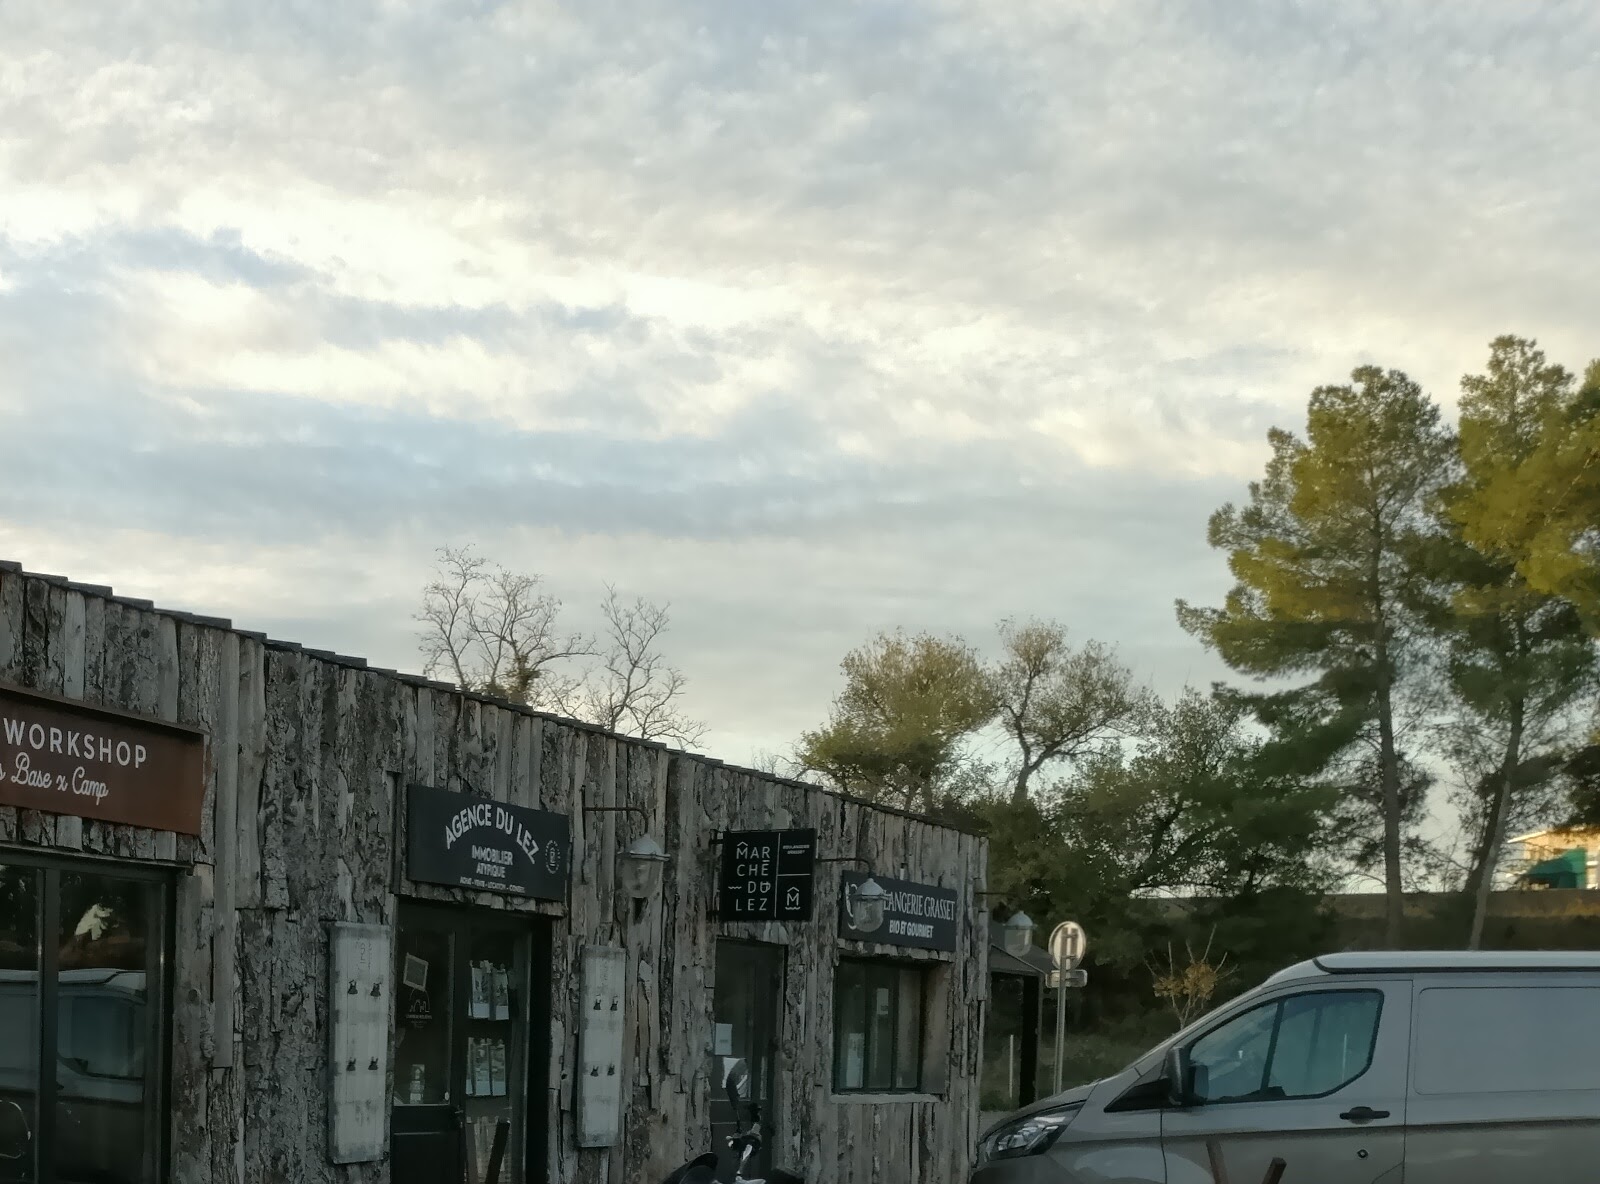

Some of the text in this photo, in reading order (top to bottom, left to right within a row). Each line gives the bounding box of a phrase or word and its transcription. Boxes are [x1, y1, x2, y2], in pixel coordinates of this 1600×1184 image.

[3, 717, 148, 769] WORKSHOP
[11, 752, 52, 790] Base
[72, 766, 109, 805] Camp
[446, 803, 493, 850] AGENCE
[496, 807, 514, 835] DU
[516, 823, 540, 865] LEZ
[472, 844, 514, 866] IMMOBILIER
[735, 898, 768, 911] LEZ
[924, 896, 955, 920] GRASSET
[889, 919, 934, 938] BIO ET GOURMET
